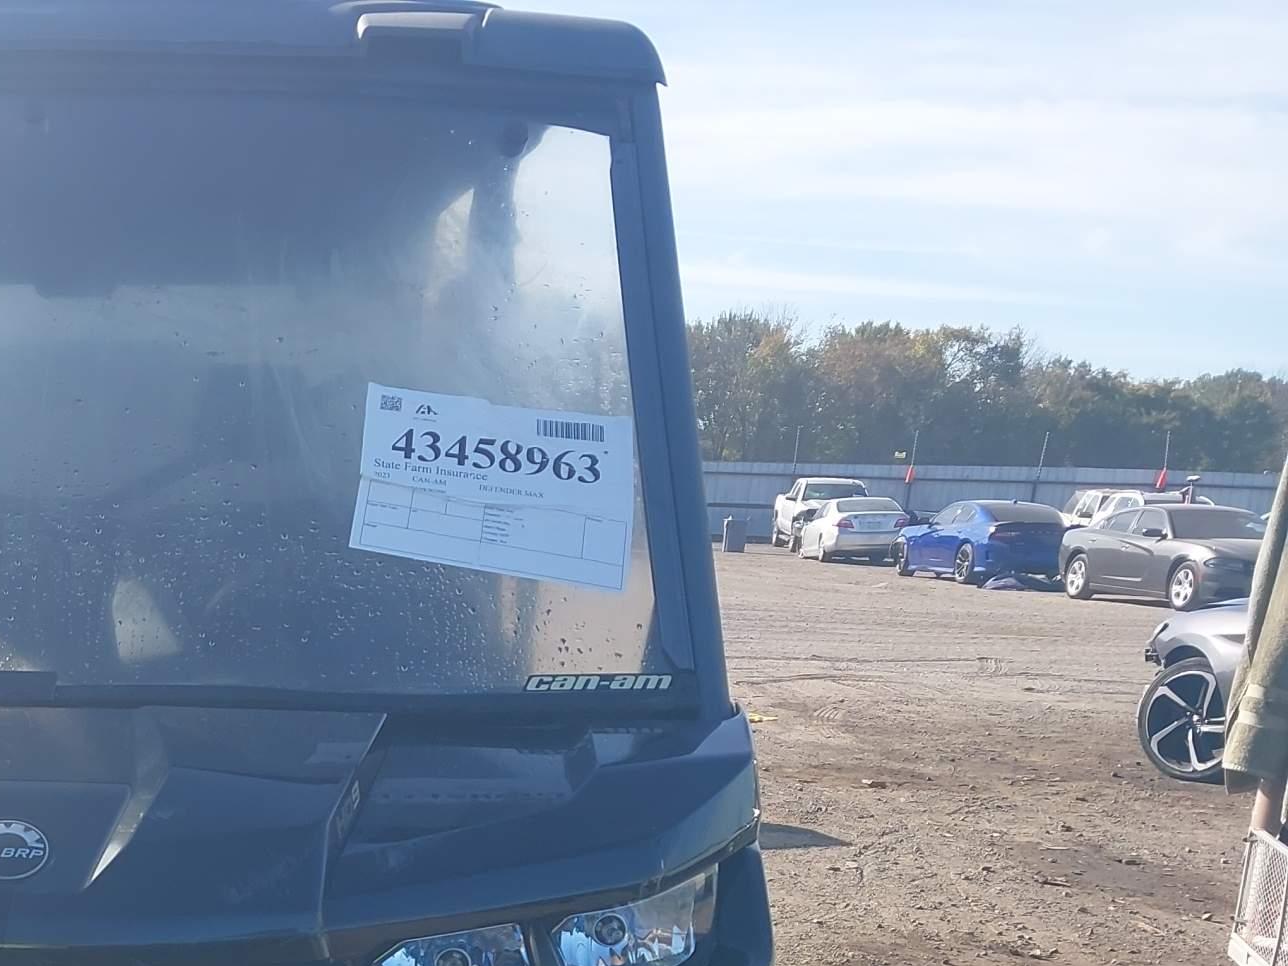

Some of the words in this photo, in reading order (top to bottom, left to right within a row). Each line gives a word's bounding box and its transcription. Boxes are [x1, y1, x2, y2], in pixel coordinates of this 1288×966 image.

[391, 428, 601, 484] 43458963
[373, 458, 401, 471] State
[404, 463, 432, 474] Farm
[435, 465, 488, 482] Insurance
[525, 674, 672, 691] can-am
[0, 847, 44, 859] BRP
